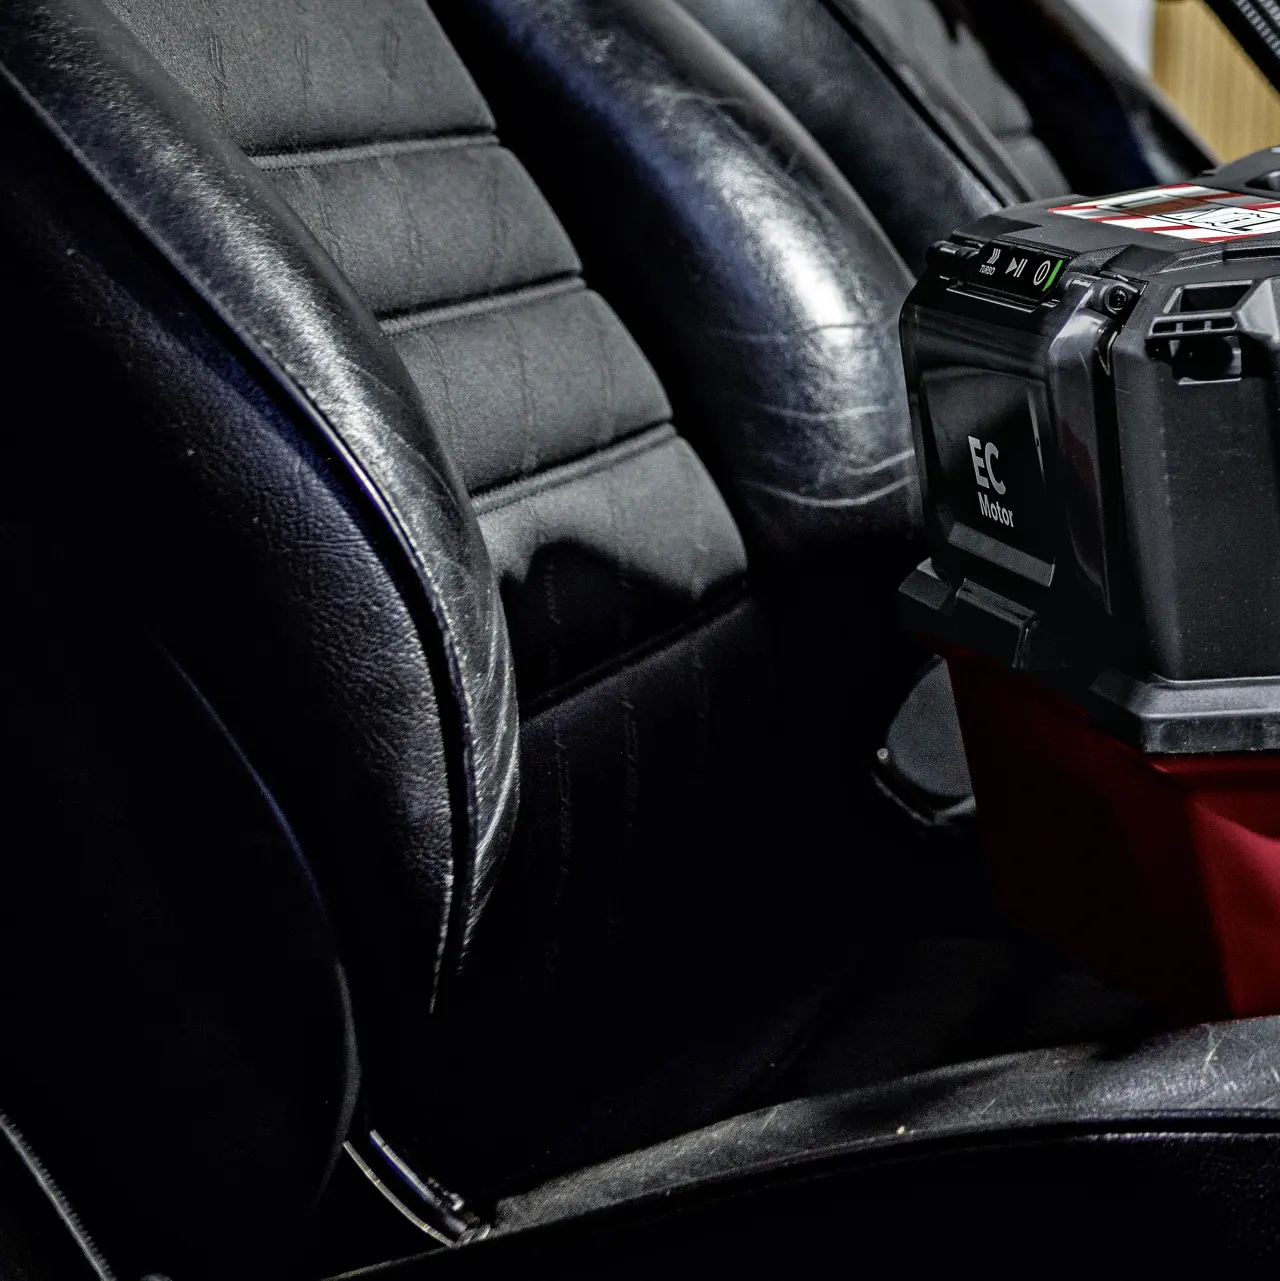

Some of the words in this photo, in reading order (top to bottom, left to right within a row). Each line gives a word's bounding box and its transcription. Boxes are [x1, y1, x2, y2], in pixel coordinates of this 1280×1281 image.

[979, 264, 996, 276] TURBO
[967, 435, 1007, 495] EC
[977, 491, 1014, 528] Motor
